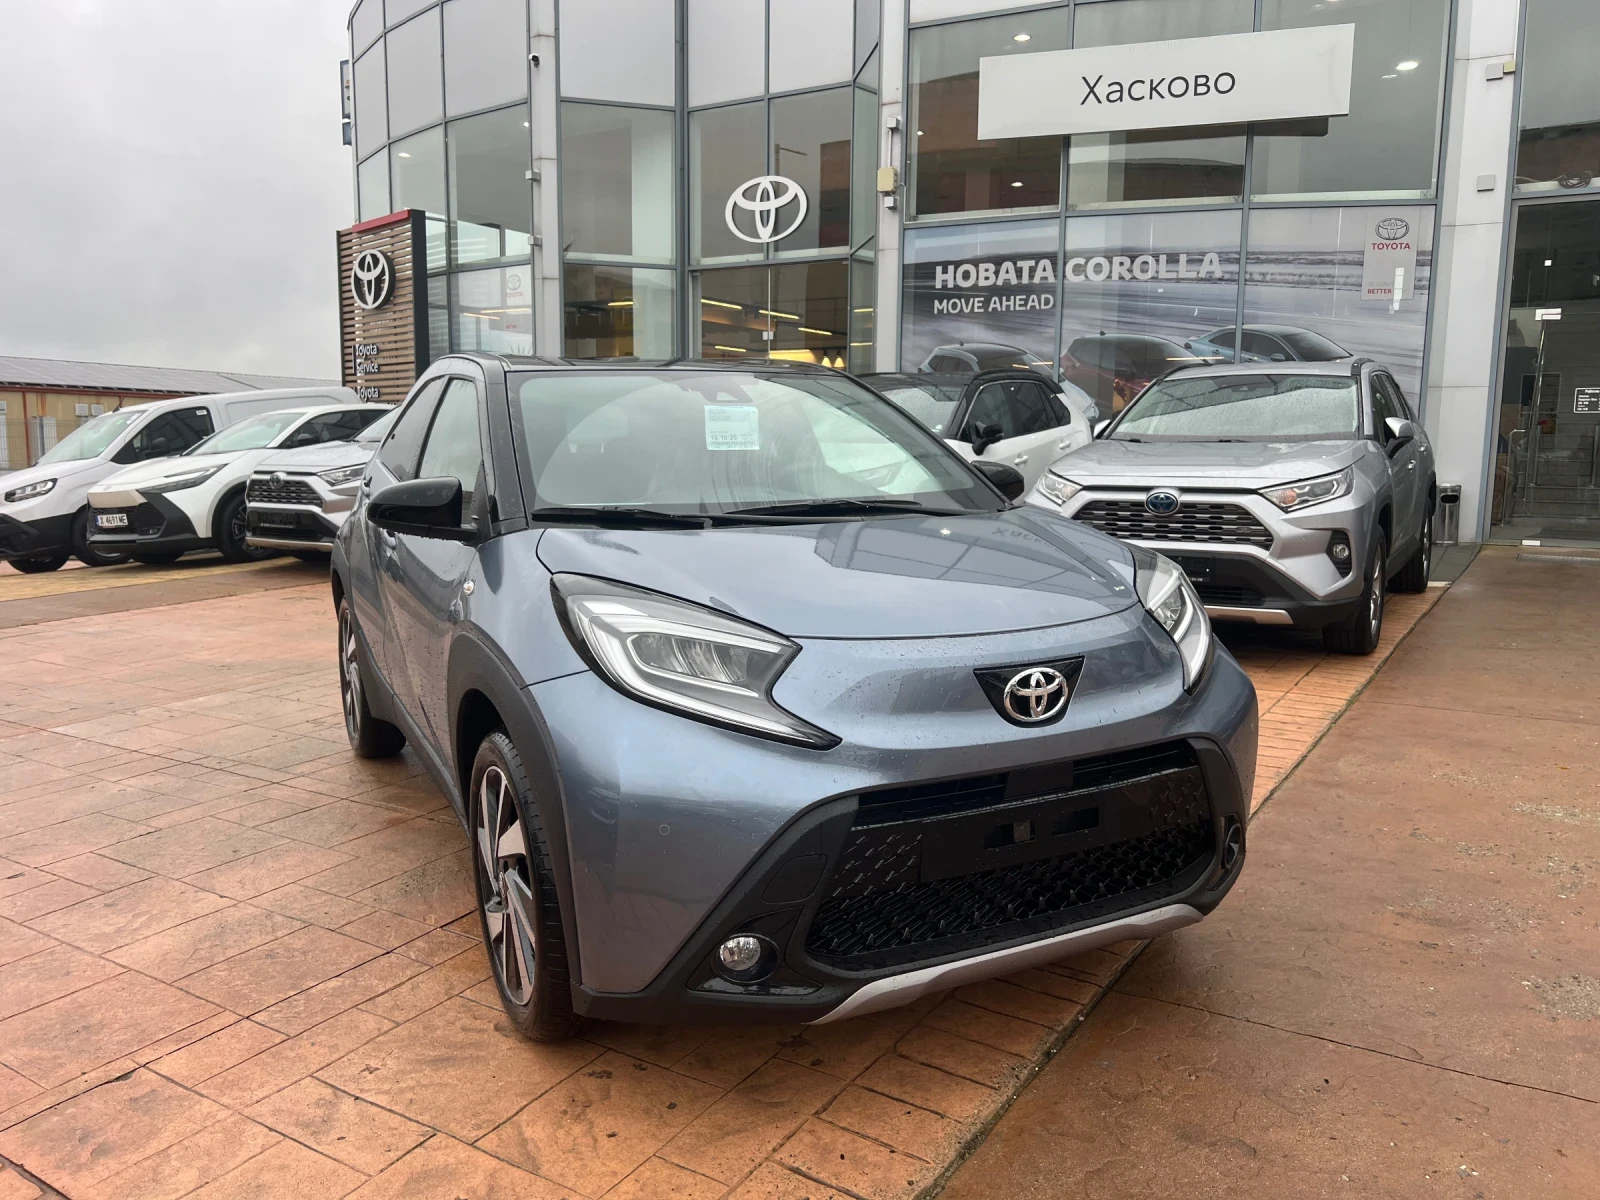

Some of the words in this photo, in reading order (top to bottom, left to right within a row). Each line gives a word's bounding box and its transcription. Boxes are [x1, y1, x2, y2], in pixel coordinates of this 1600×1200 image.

[1080, 72, 1236, 106] Хасково
[1065, 252, 1223, 282] COROLLA
[933, 297, 984, 315] MOVE
[988, 294, 1054, 312] AHEAD
[355, 344, 377, 359] Toyota
[355, 362, 379, 374] Service
